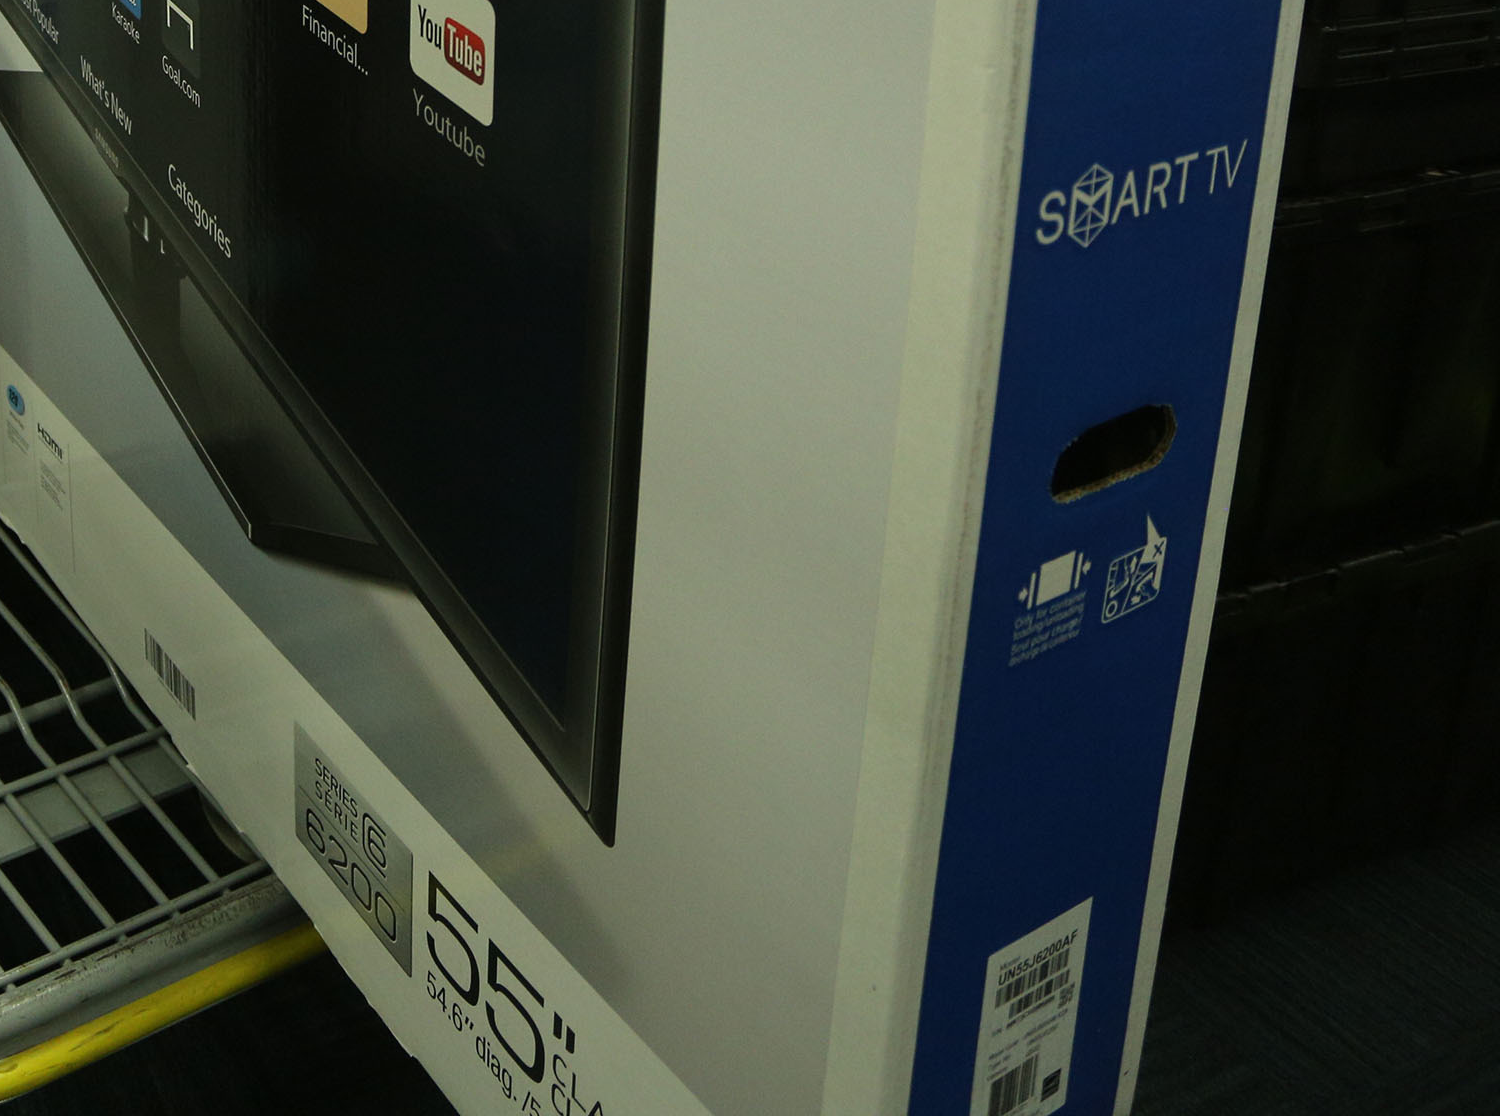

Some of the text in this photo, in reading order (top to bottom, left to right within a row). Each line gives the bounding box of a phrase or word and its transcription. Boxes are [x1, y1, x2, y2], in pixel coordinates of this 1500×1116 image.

[32, 1, 59, 45] Popular
[111, 1, 140, 45] Karaoke
[302, 4, 368, 76] Financial...
[80, 54, 132, 136] What's New
[161, 54, 201, 109] Goal.com
[412, 87, 486, 167] Youtube
[1206, 139, 1248, 195] TV
[167, 163, 232, 260] Categories
[37, 422, 63, 461] HDMI
[314, 757, 359, 820] SERIES
[314, 780, 359, 843] SÉRIE
[306, 808, 397, 943] 6200
[425, 869, 576, 1084] 55"
[998, 928, 1079, 986] UN55J6200AF
[475, 1033, 517, 1102] diag.
